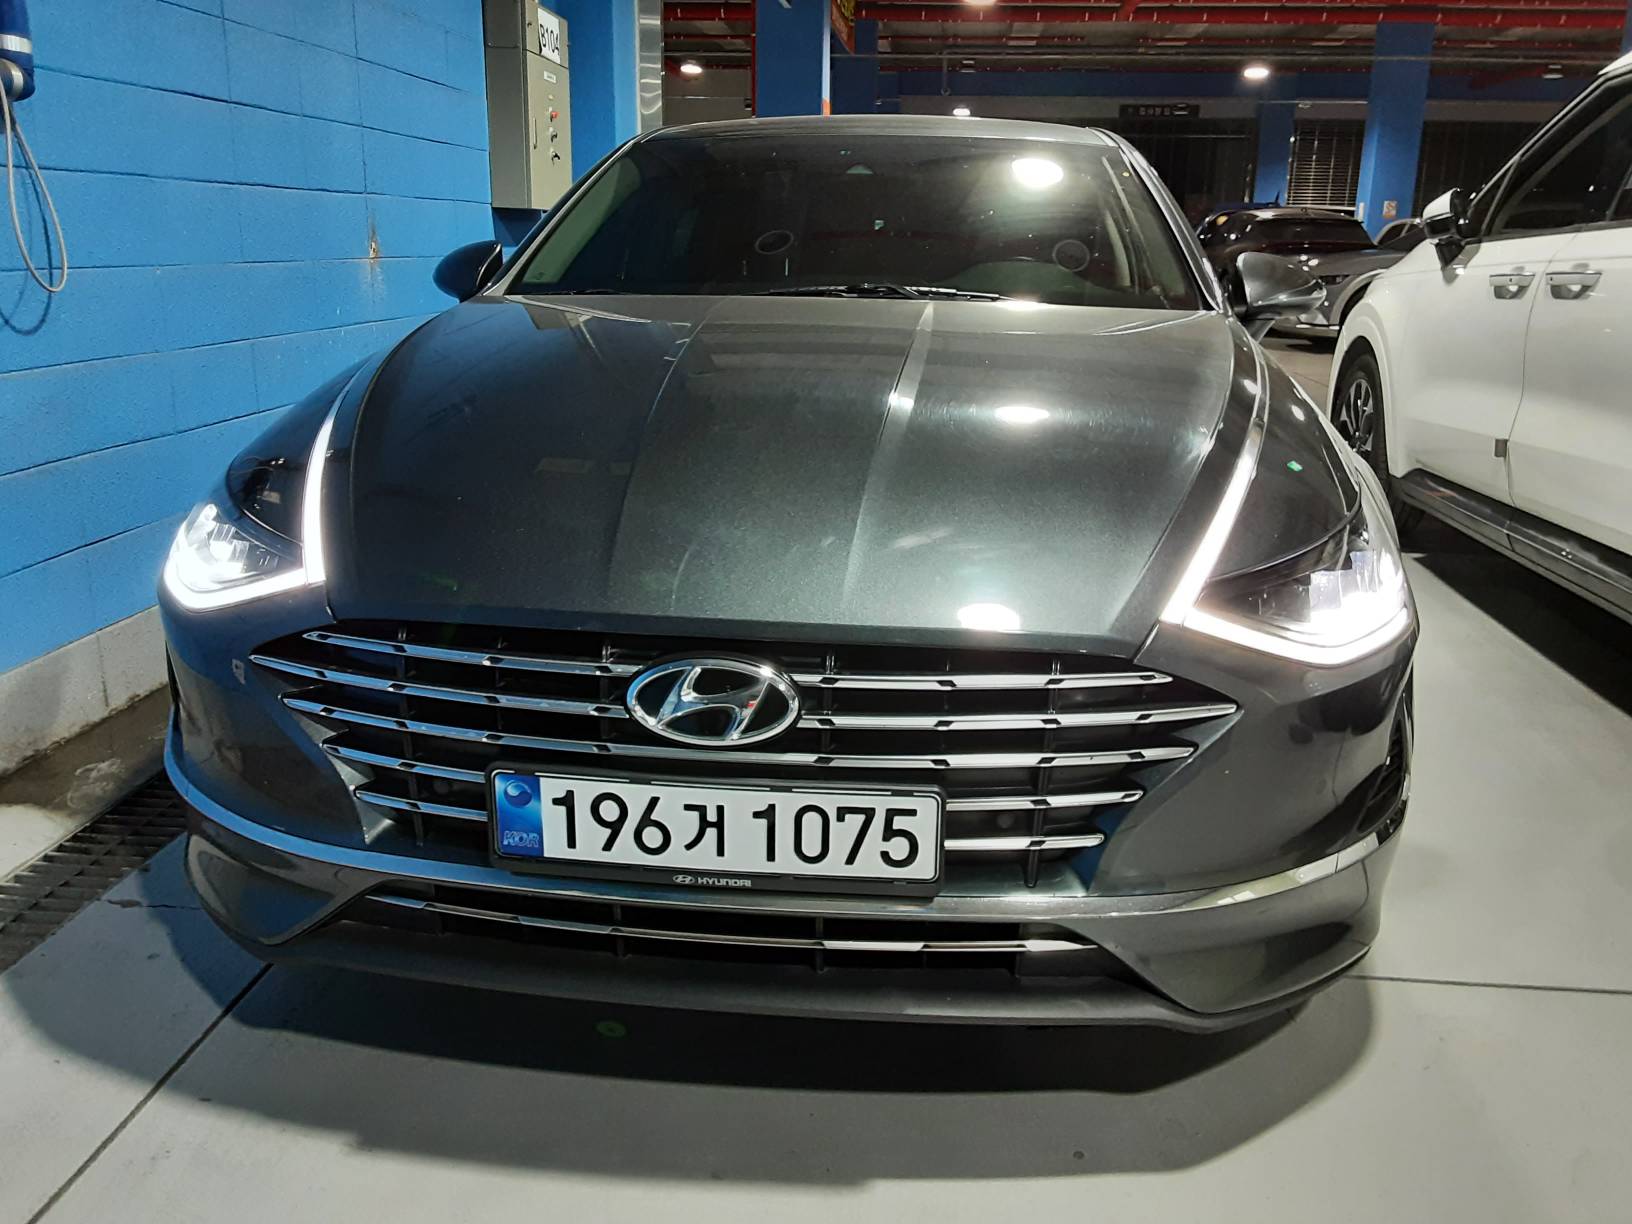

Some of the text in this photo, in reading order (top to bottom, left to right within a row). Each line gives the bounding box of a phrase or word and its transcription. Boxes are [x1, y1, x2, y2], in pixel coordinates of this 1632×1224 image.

[540, 24, 559, 55] B104
[503, 830, 539, 848] KOR
[552, 789, 919, 869] 196거 1075
[697, 877, 752, 887] HYUNDAI
